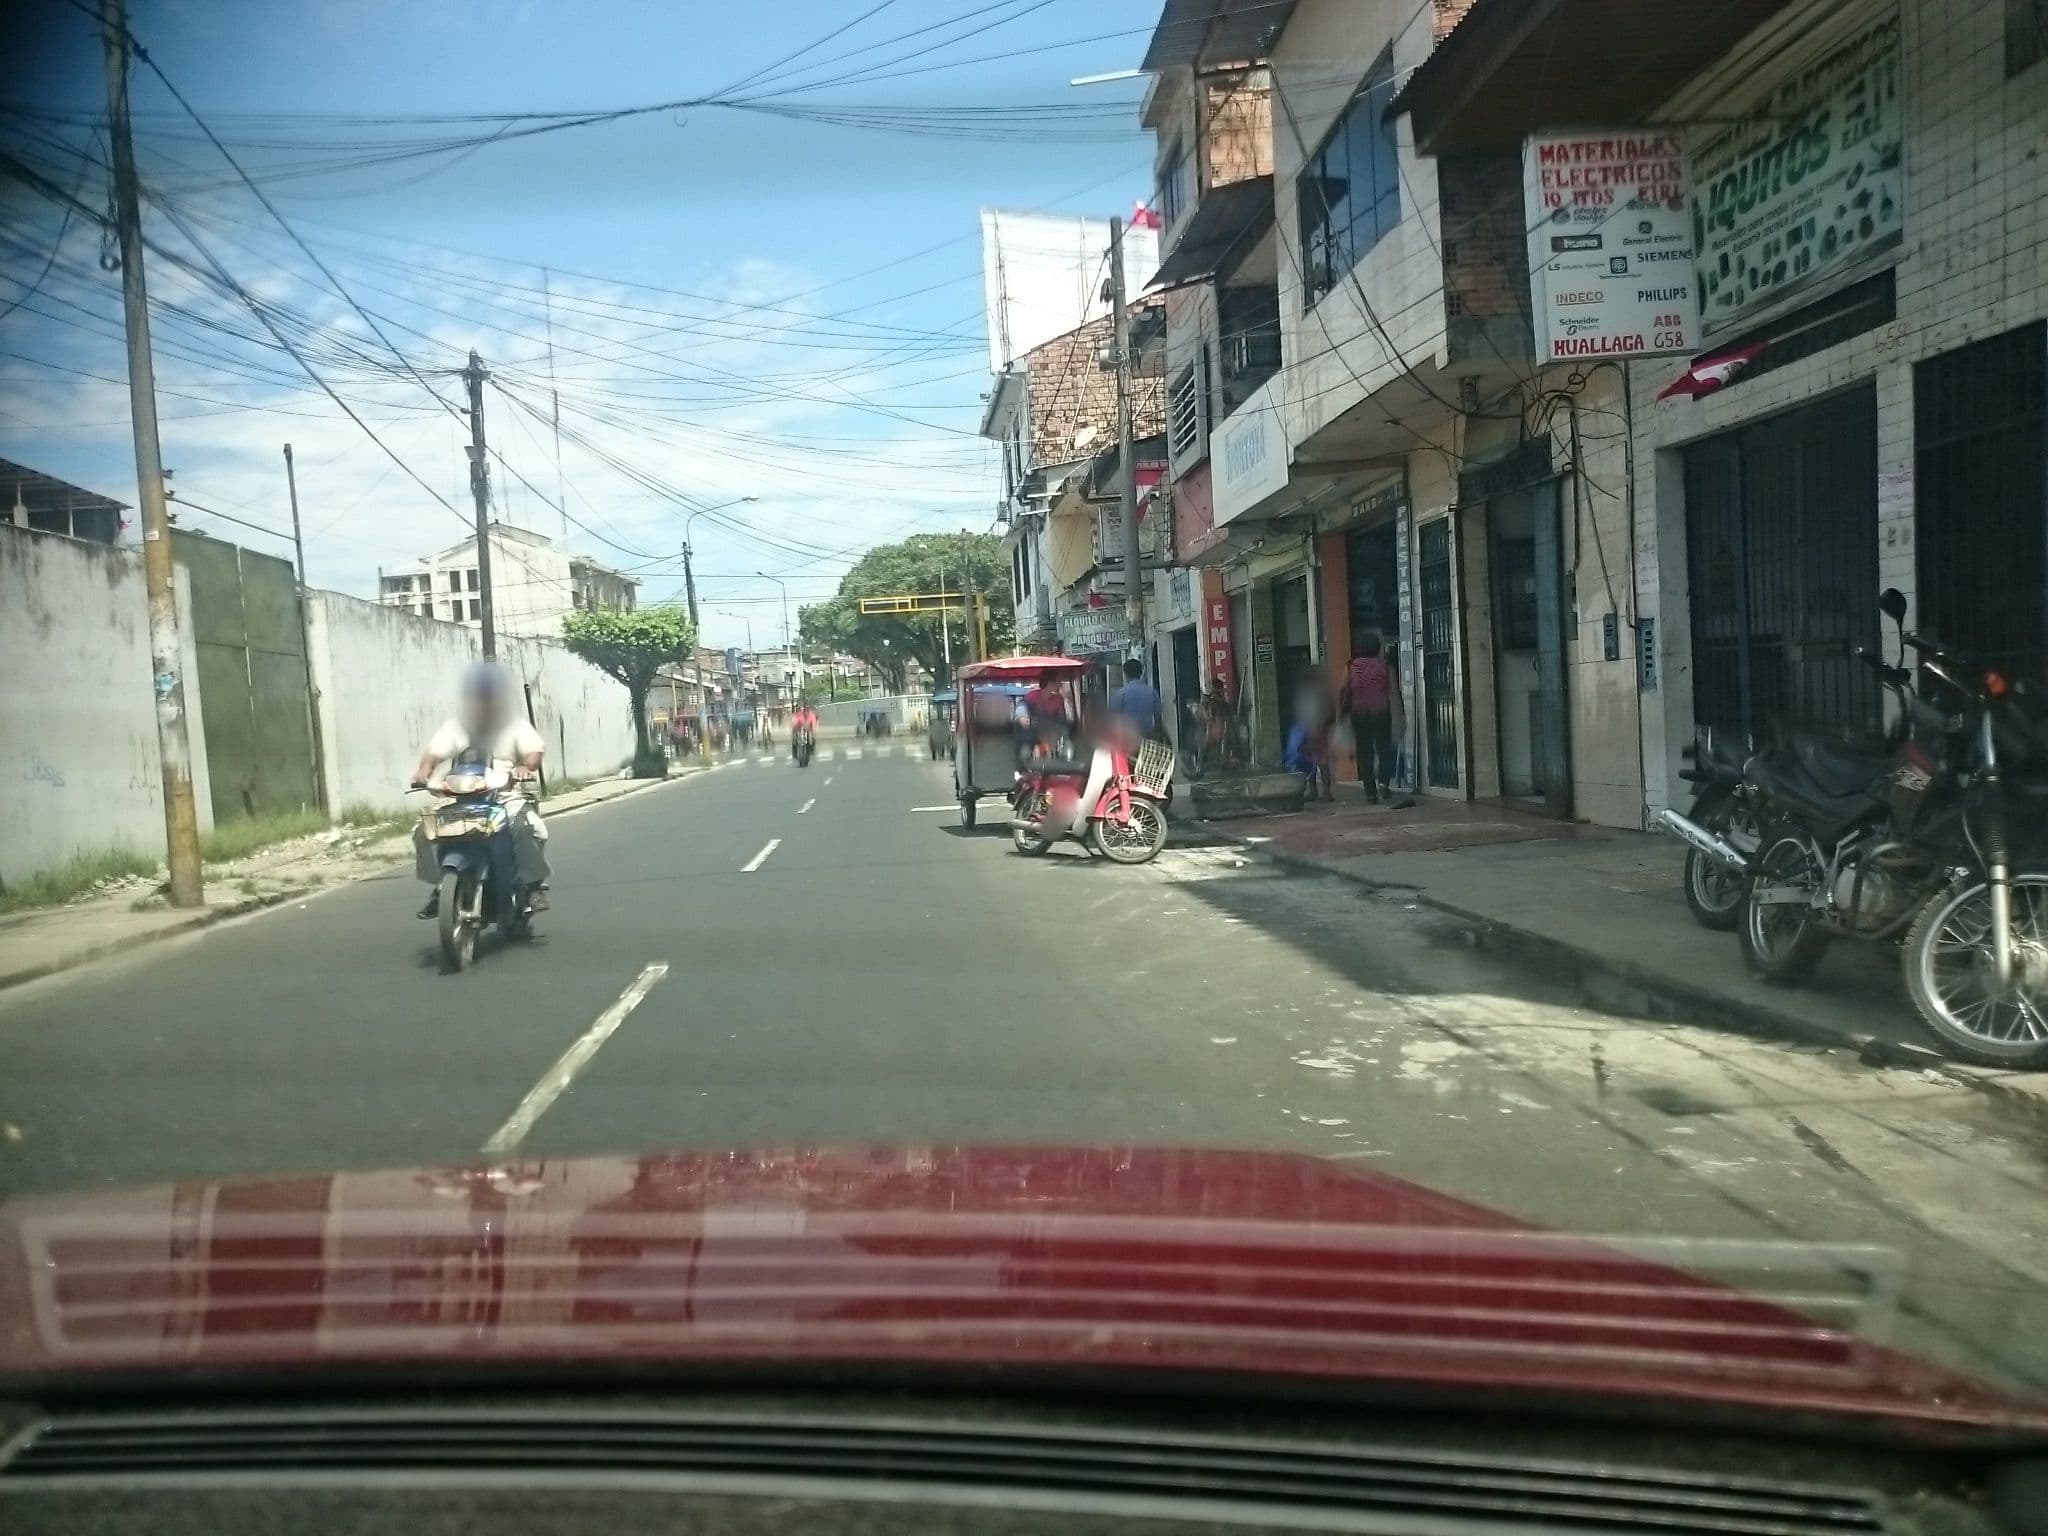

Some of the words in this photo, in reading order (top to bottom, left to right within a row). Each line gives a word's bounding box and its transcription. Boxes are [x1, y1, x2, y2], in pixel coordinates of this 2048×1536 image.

[1539, 136, 1682, 165] MATERIALES
[1542, 161, 1682, 189] ELECTRICOS
[1623, 236, 1652, 246] General
[1637, 249, 1693, 263] SIEMENS
[1556, 291, 1604, 304] INDECO
[1638, 287, 1687, 303] PHILLIPS
[1560, 316, 1599, 326] Schneider
[1654, 315, 1681, 328] ABB
[1554, 334, 1645, 356] HUALLAGA
